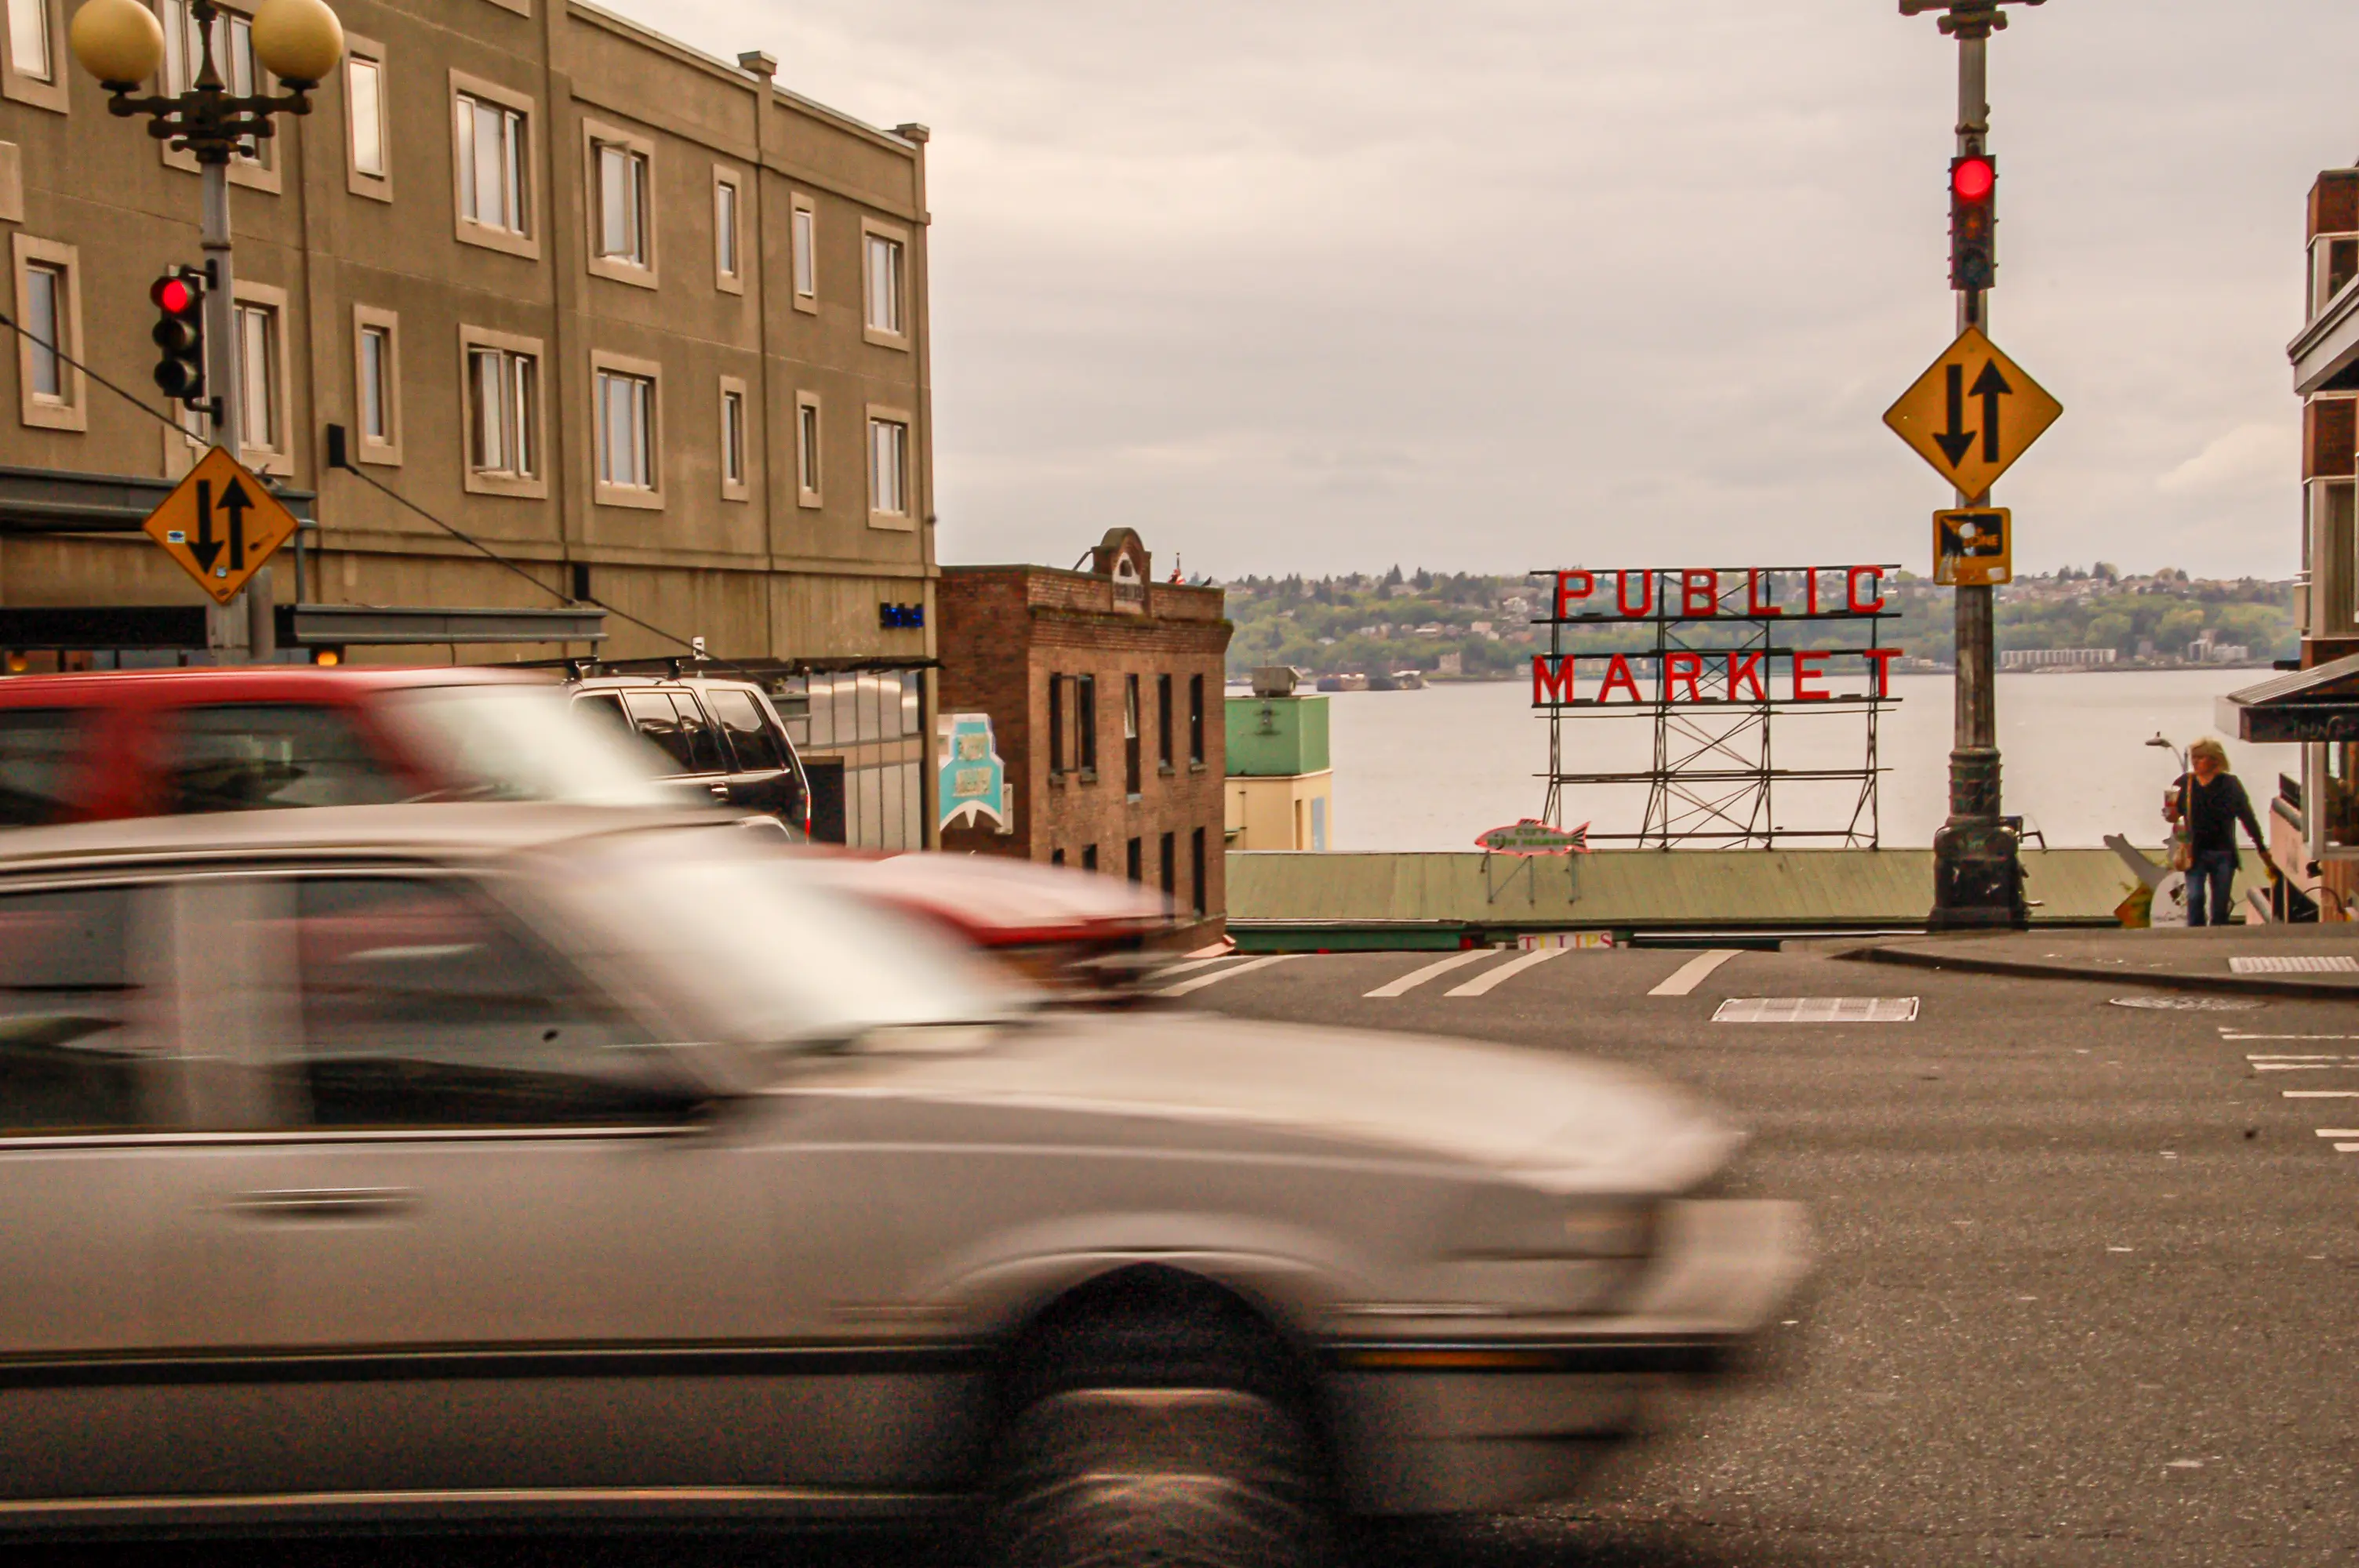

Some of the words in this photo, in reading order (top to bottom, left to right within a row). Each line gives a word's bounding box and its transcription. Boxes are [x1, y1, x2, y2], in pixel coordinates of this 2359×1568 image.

[1557, 565, 1885, 618] PUBLIC
[1532, 648, 1903, 703] MARKET
[1519, 932, 1612, 950] TULIPS
